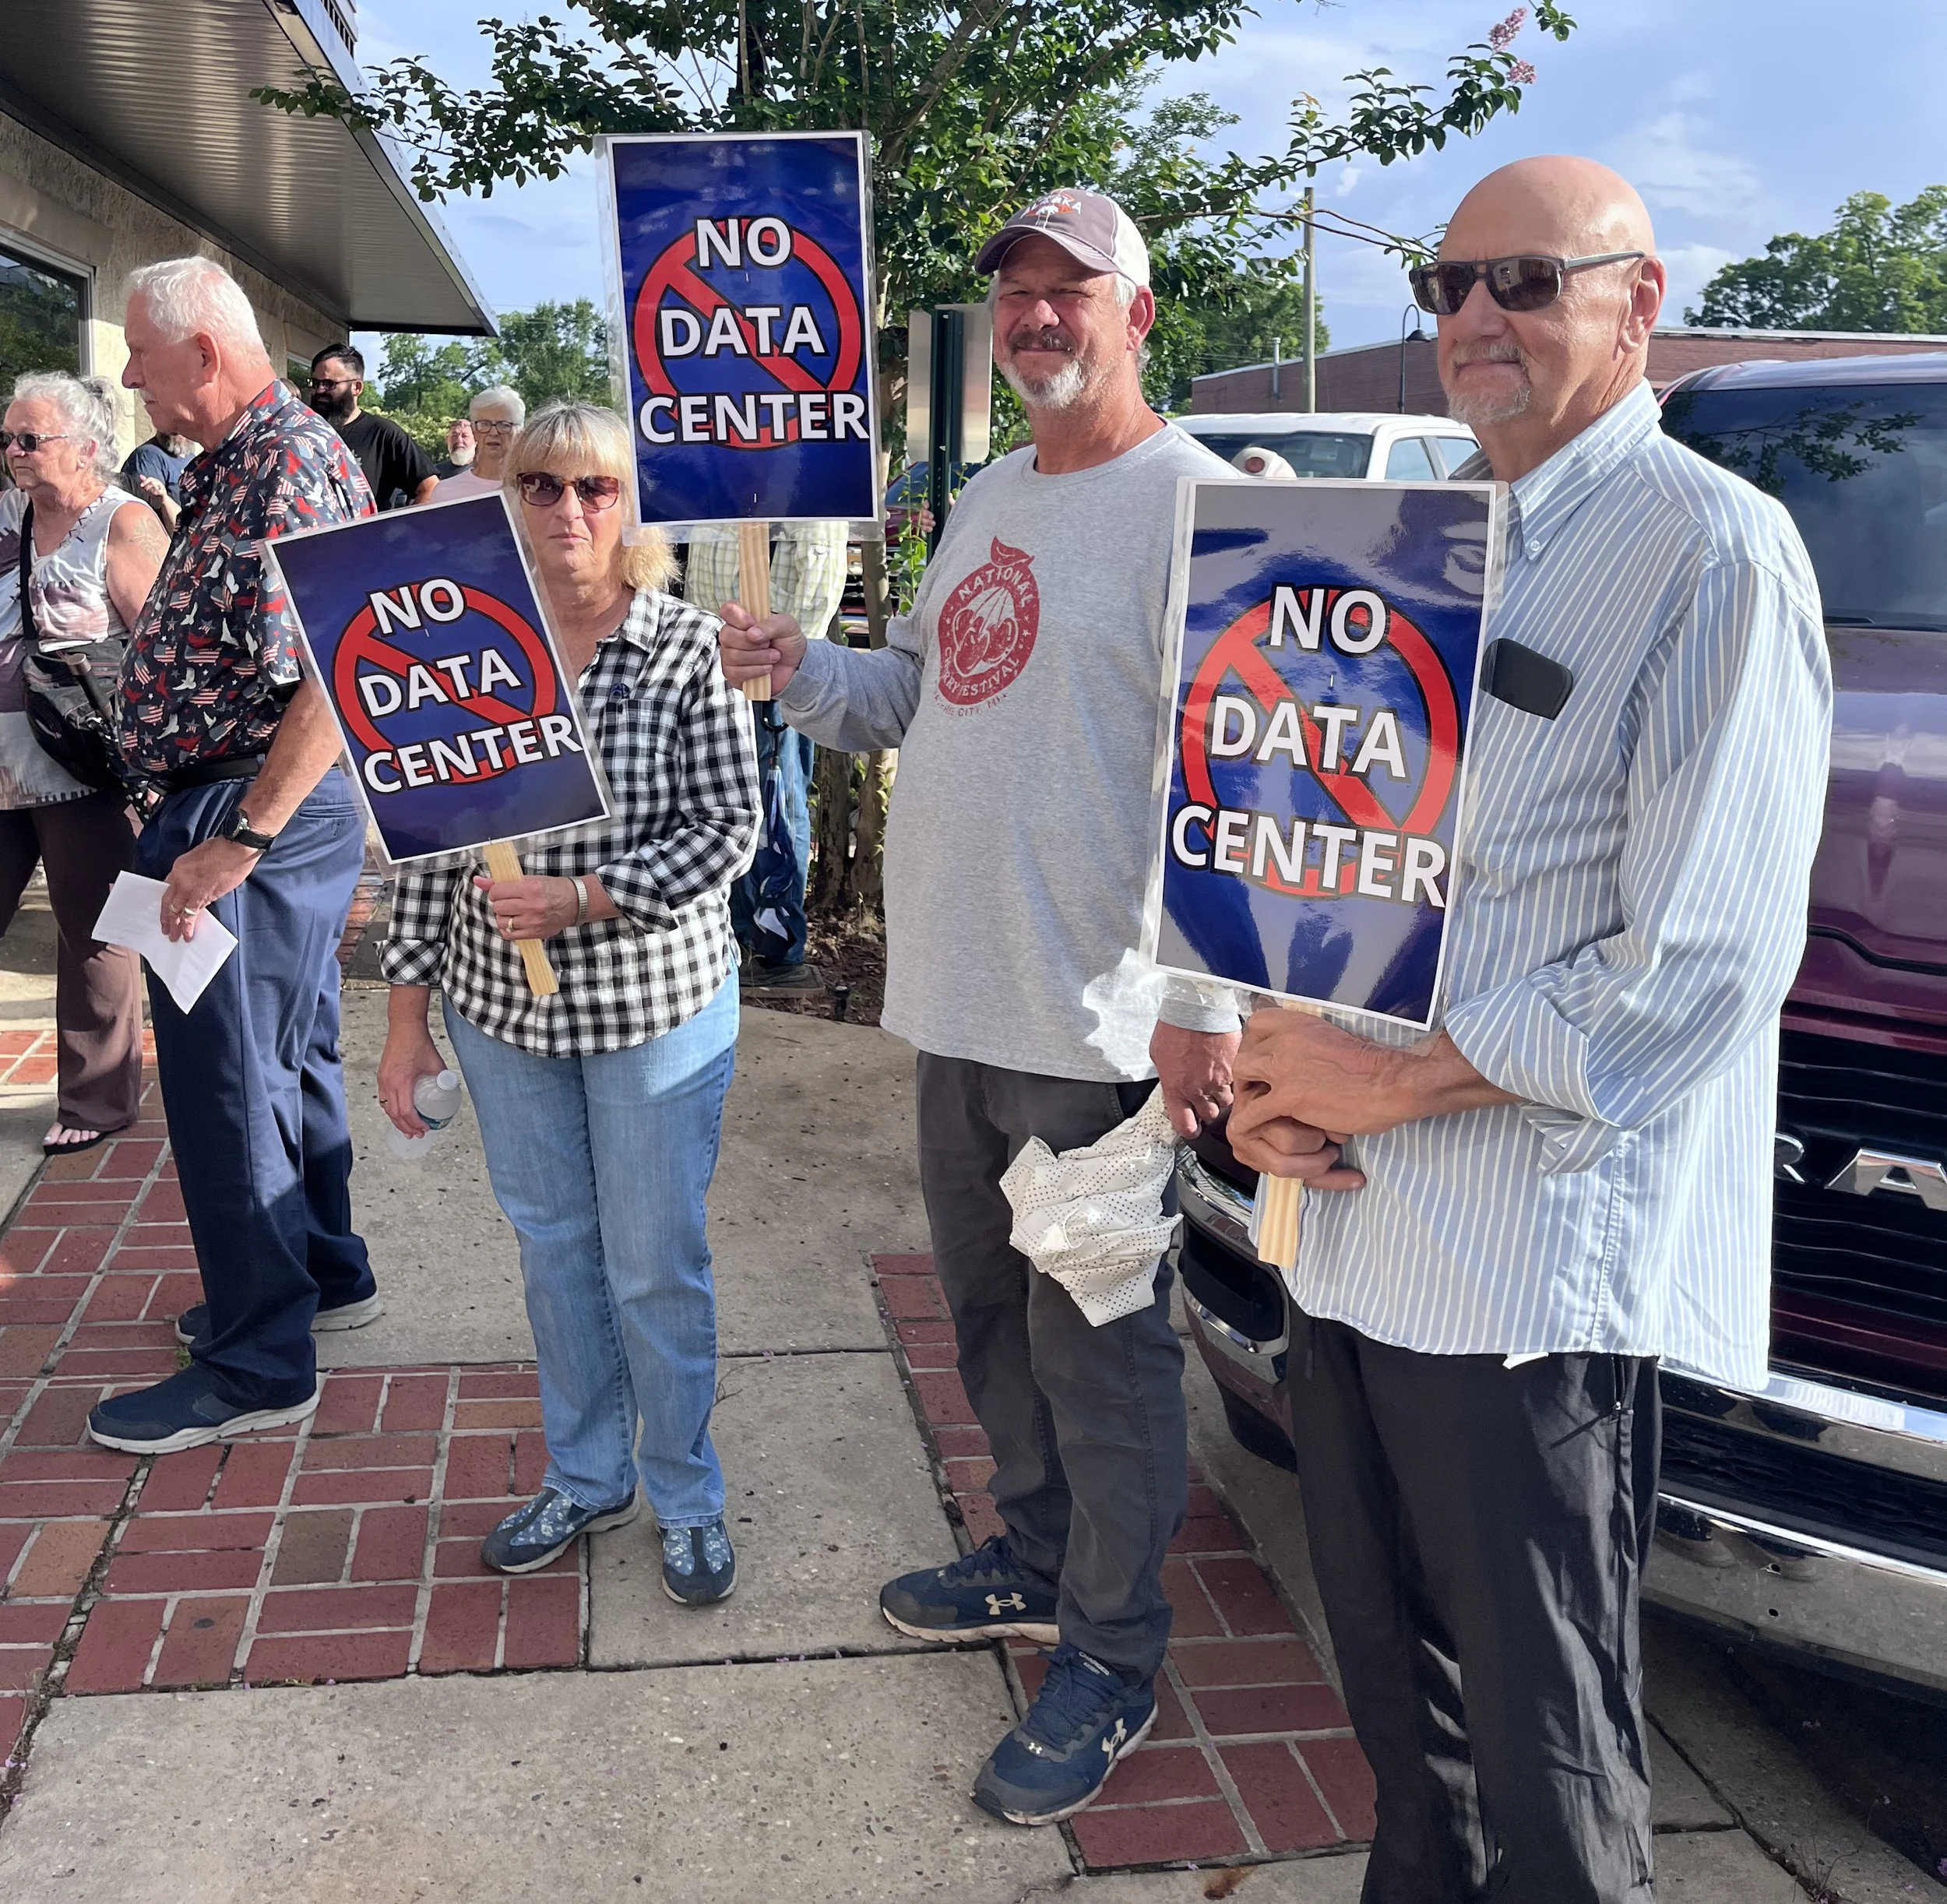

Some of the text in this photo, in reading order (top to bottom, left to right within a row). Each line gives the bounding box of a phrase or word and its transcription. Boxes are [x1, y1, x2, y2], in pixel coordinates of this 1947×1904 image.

[696, 216, 792, 268] NO
[660, 305, 826, 357] DATA
[639, 392, 870, 444] CENTER
[369, 578, 465, 635] NO
[959, 566, 1033, 607] NATIONAL
[1269, 586, 1387, 654] NO
[358, 649, 522, 718] DATA
[956, 657, 1020, 697] ESTIVAL
[363, 714, 584, 794] CENTER
[1210, 695, 1407, 779] DATA
[1172, 804, 1447, 909] CENTER
